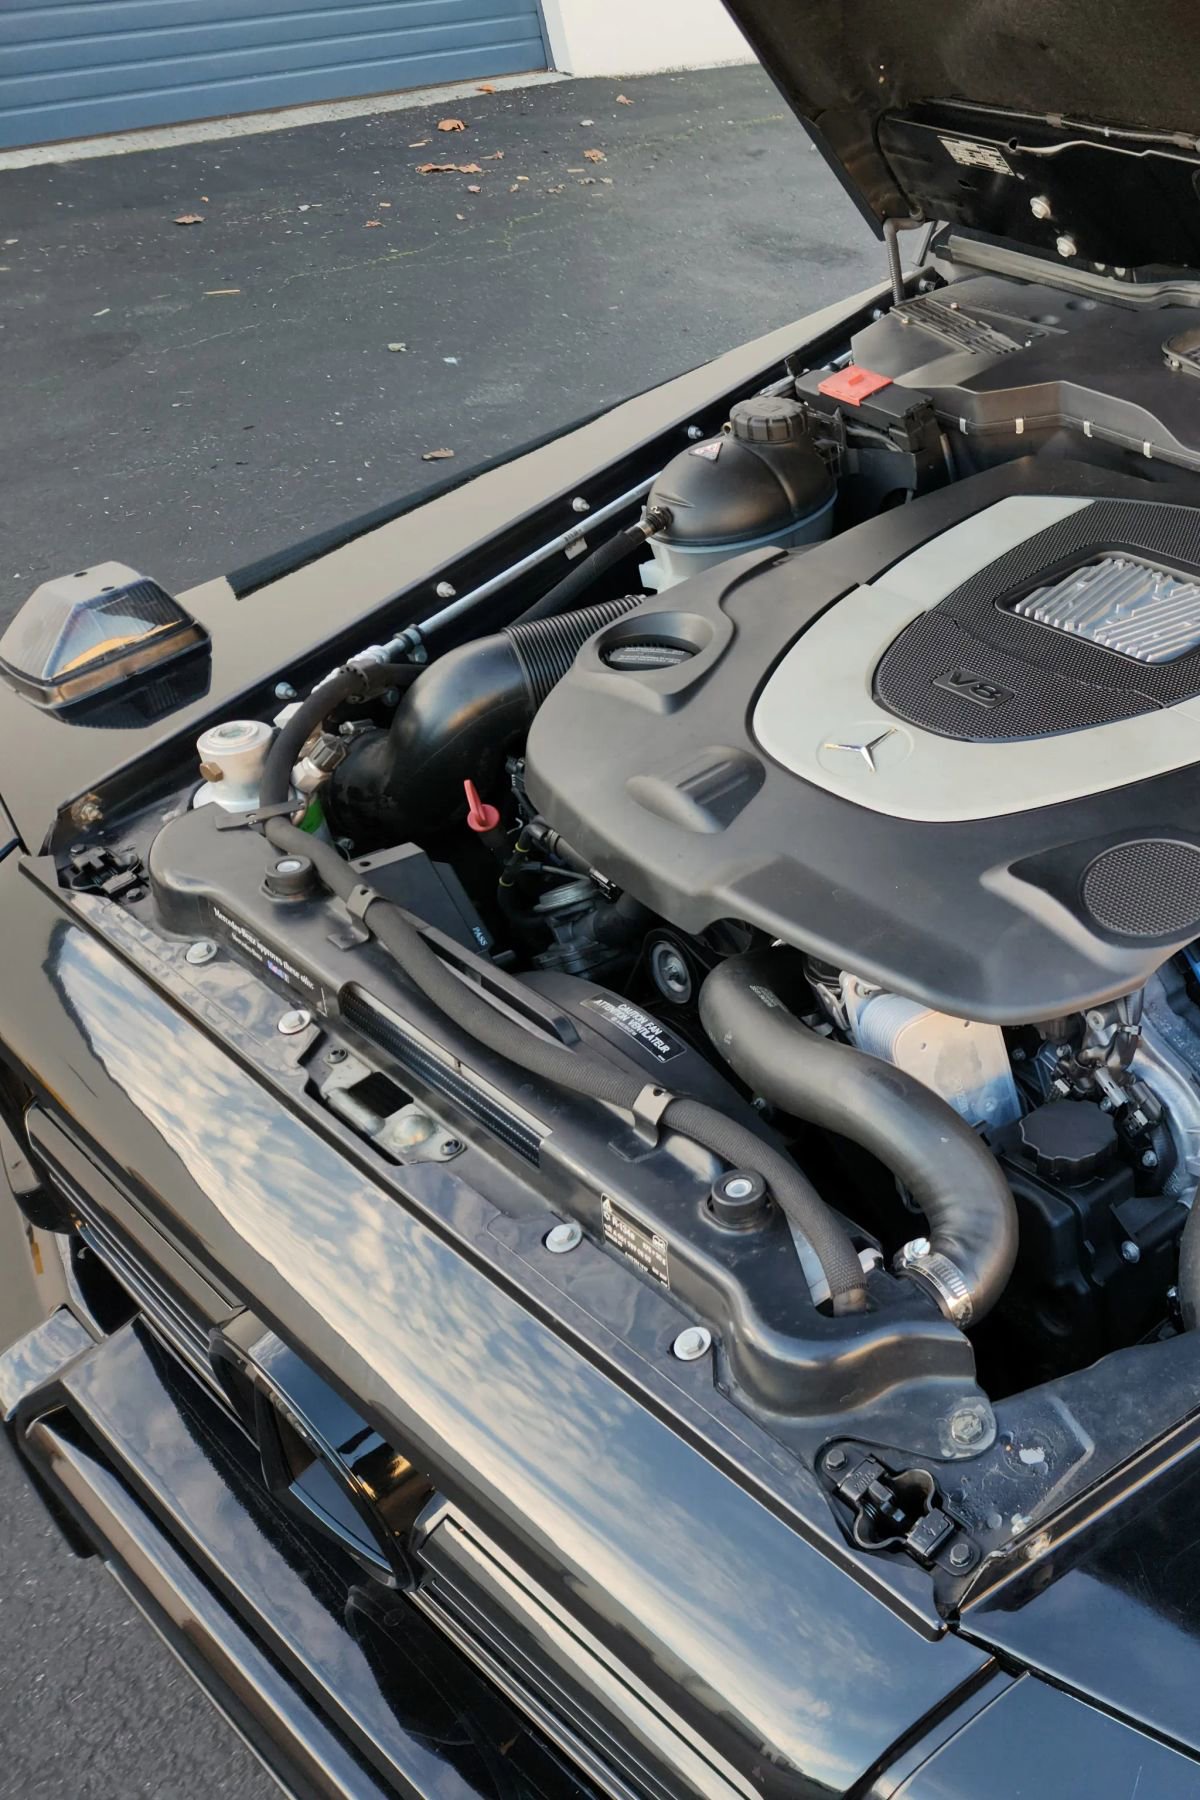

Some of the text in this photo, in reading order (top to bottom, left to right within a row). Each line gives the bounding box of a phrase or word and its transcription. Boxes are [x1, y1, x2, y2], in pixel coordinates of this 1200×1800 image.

[948, 670, 1001, 701] V8
[257, 941, 283, 966] approves
[283, 961, 300, 979] these
[593, 999, 631, 1022] ATTENTION
[628, 1020, 671, 1054] VENTILATEUR
[618, 1003, 648, 1024] CAUTION
[645, 1022, 663, 1036] FAN
